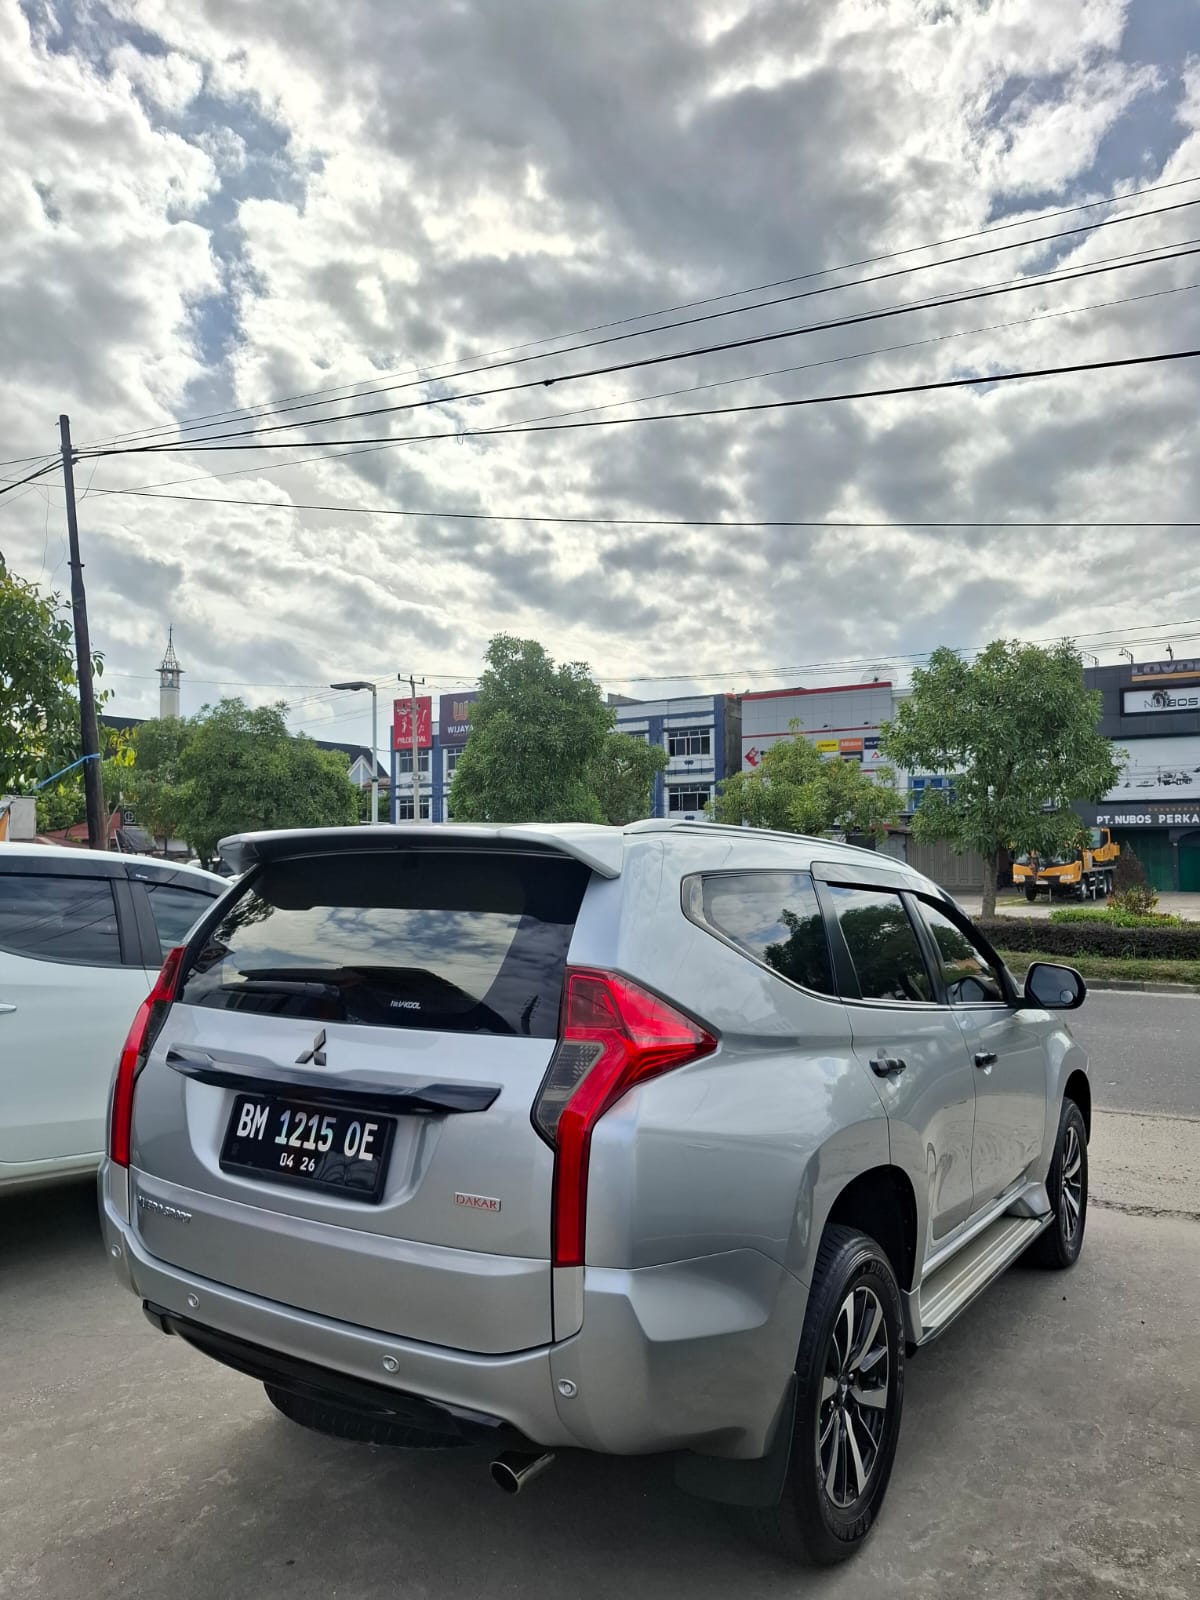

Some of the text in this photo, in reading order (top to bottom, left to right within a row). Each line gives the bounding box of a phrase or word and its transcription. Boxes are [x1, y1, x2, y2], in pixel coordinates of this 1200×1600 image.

[1158, 813, 1200, 824] PERKA
[236, 1103, 270, 1140] BM
[274, 1110, 337, 1152] 1215
[279, 1152, 316, 1172] 04 26
[456, 1193, 497, 1209] DAKAR
